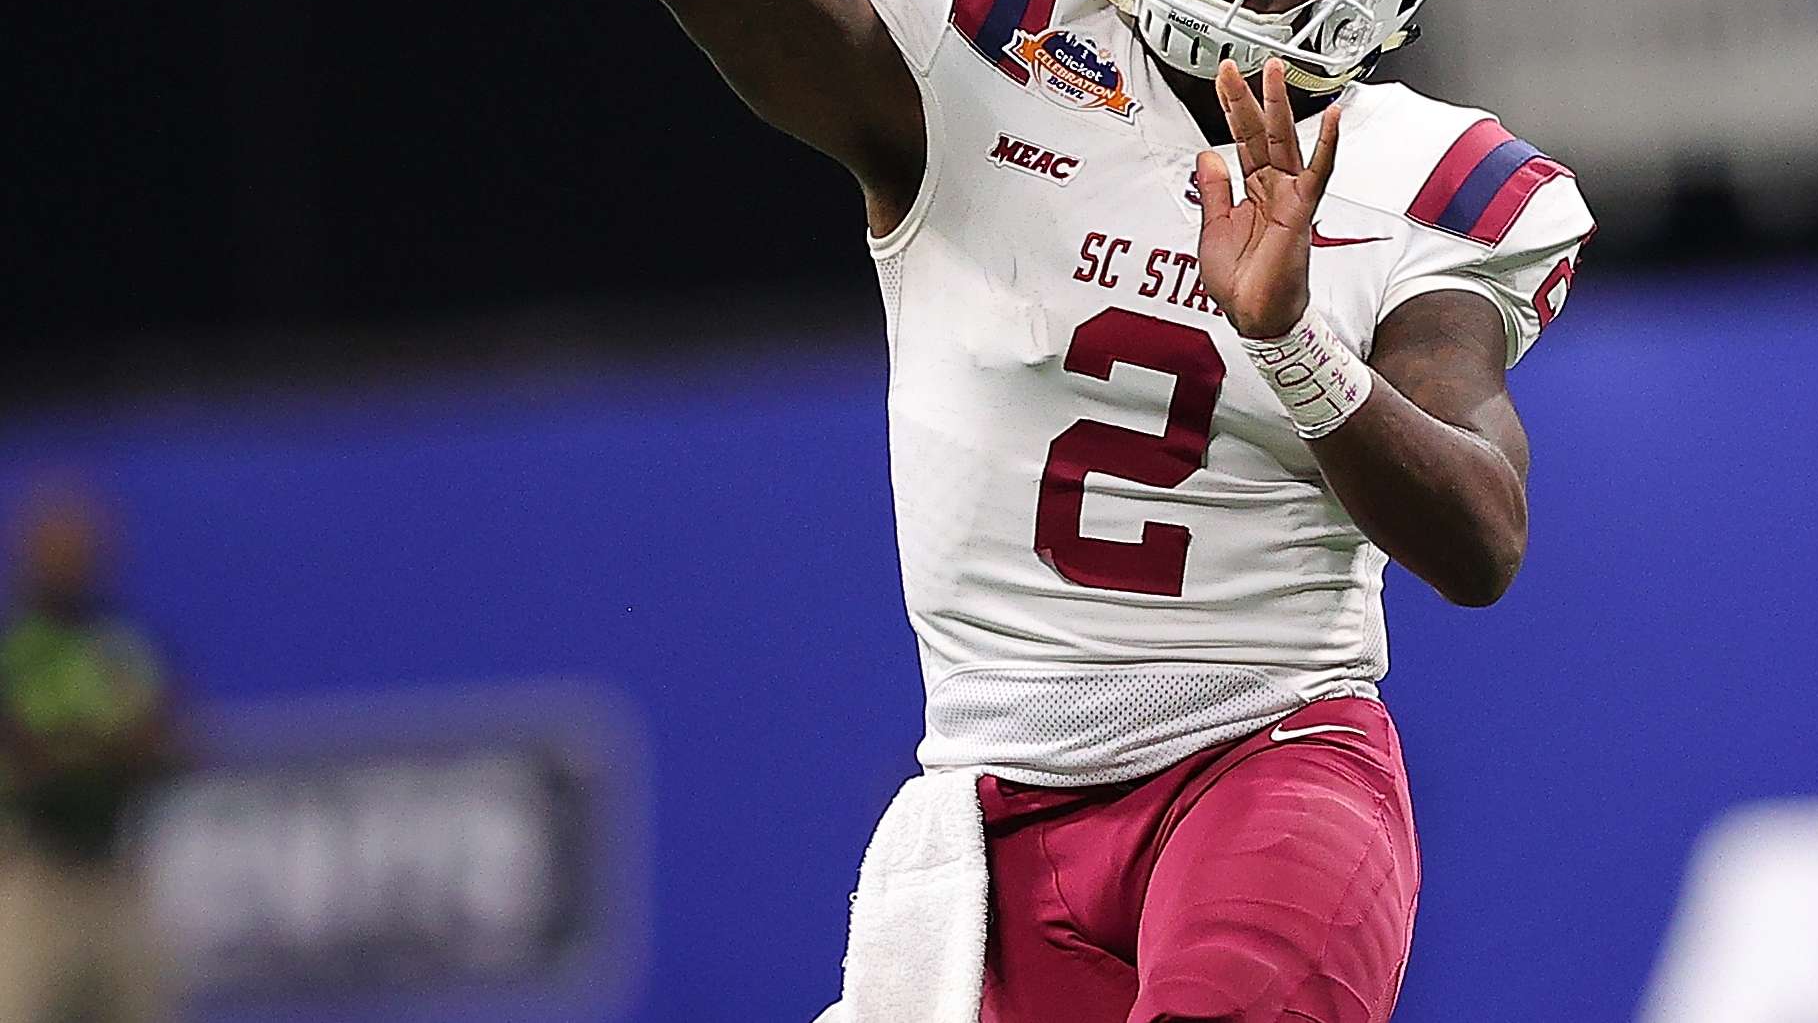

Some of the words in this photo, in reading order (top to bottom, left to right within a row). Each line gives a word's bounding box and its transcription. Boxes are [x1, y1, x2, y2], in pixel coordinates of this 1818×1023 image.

[1034, 48, 1116, 99] CELEBRATION
[1046, 76, 1085, 100] BOWL
[1055, 48, 1103, 82] cricket
[990, 135, 1080, 179] MEAC
[1073, 232, 1132, 289] SC
[1138, 248, 1228, 317] STA
[1034, 306, 1227, 597] 2
